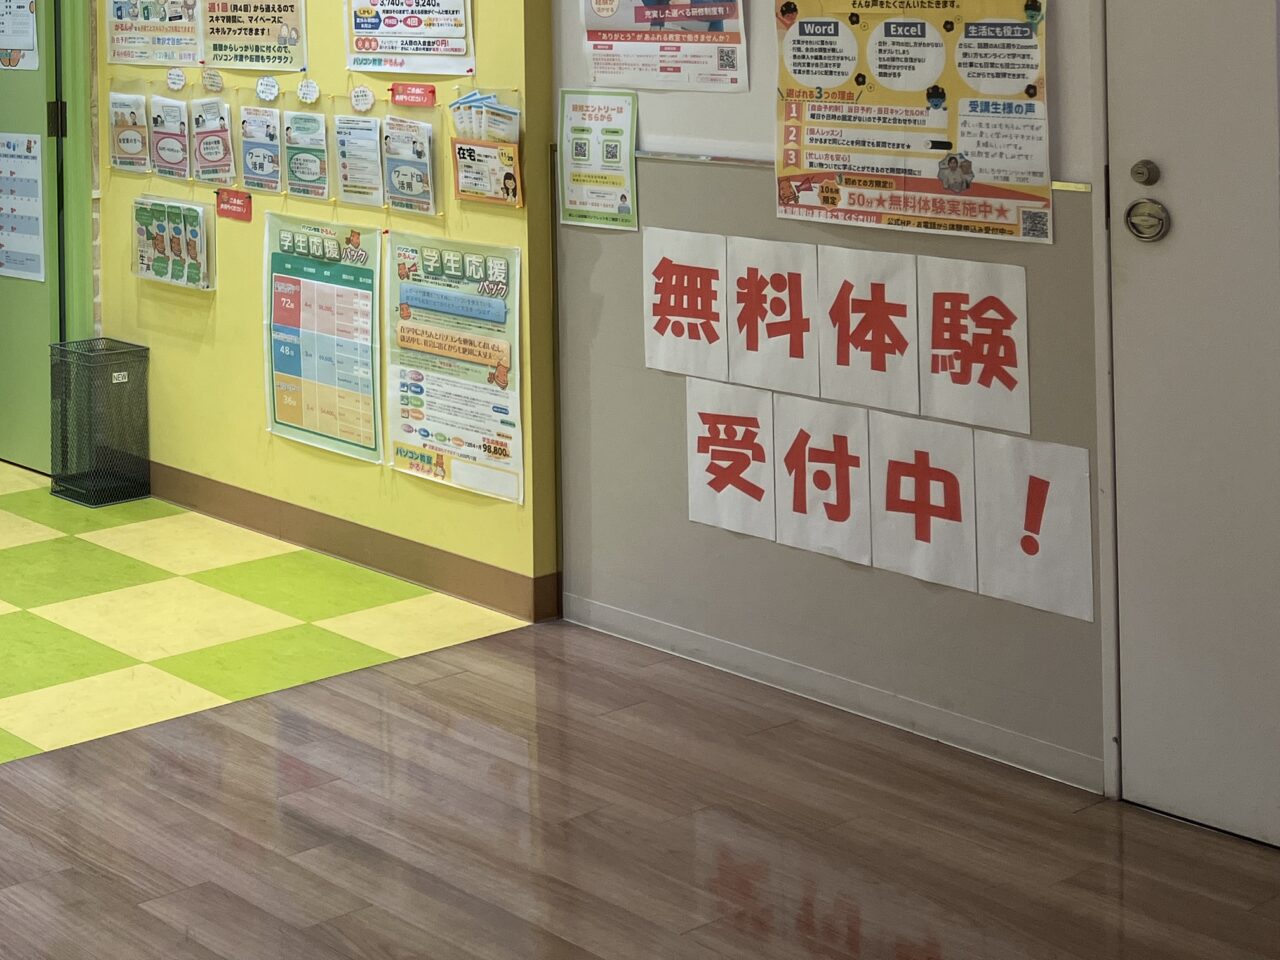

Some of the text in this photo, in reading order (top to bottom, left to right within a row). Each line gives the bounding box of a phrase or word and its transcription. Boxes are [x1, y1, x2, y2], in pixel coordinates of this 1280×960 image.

[803, 23, 835, 36] Word
[890, 23, 922, 36] Excel
[968, 24, 1031, 38] 生活にも役立つ
[280, 229, 341, 261] 学生応援
[422, 246, 508, 282] 学生応援
[478, 280, 508, 296] パック
[651, 256, 1020, 392] 無料体験
[696, 410, 1051, 557] 受付中!
